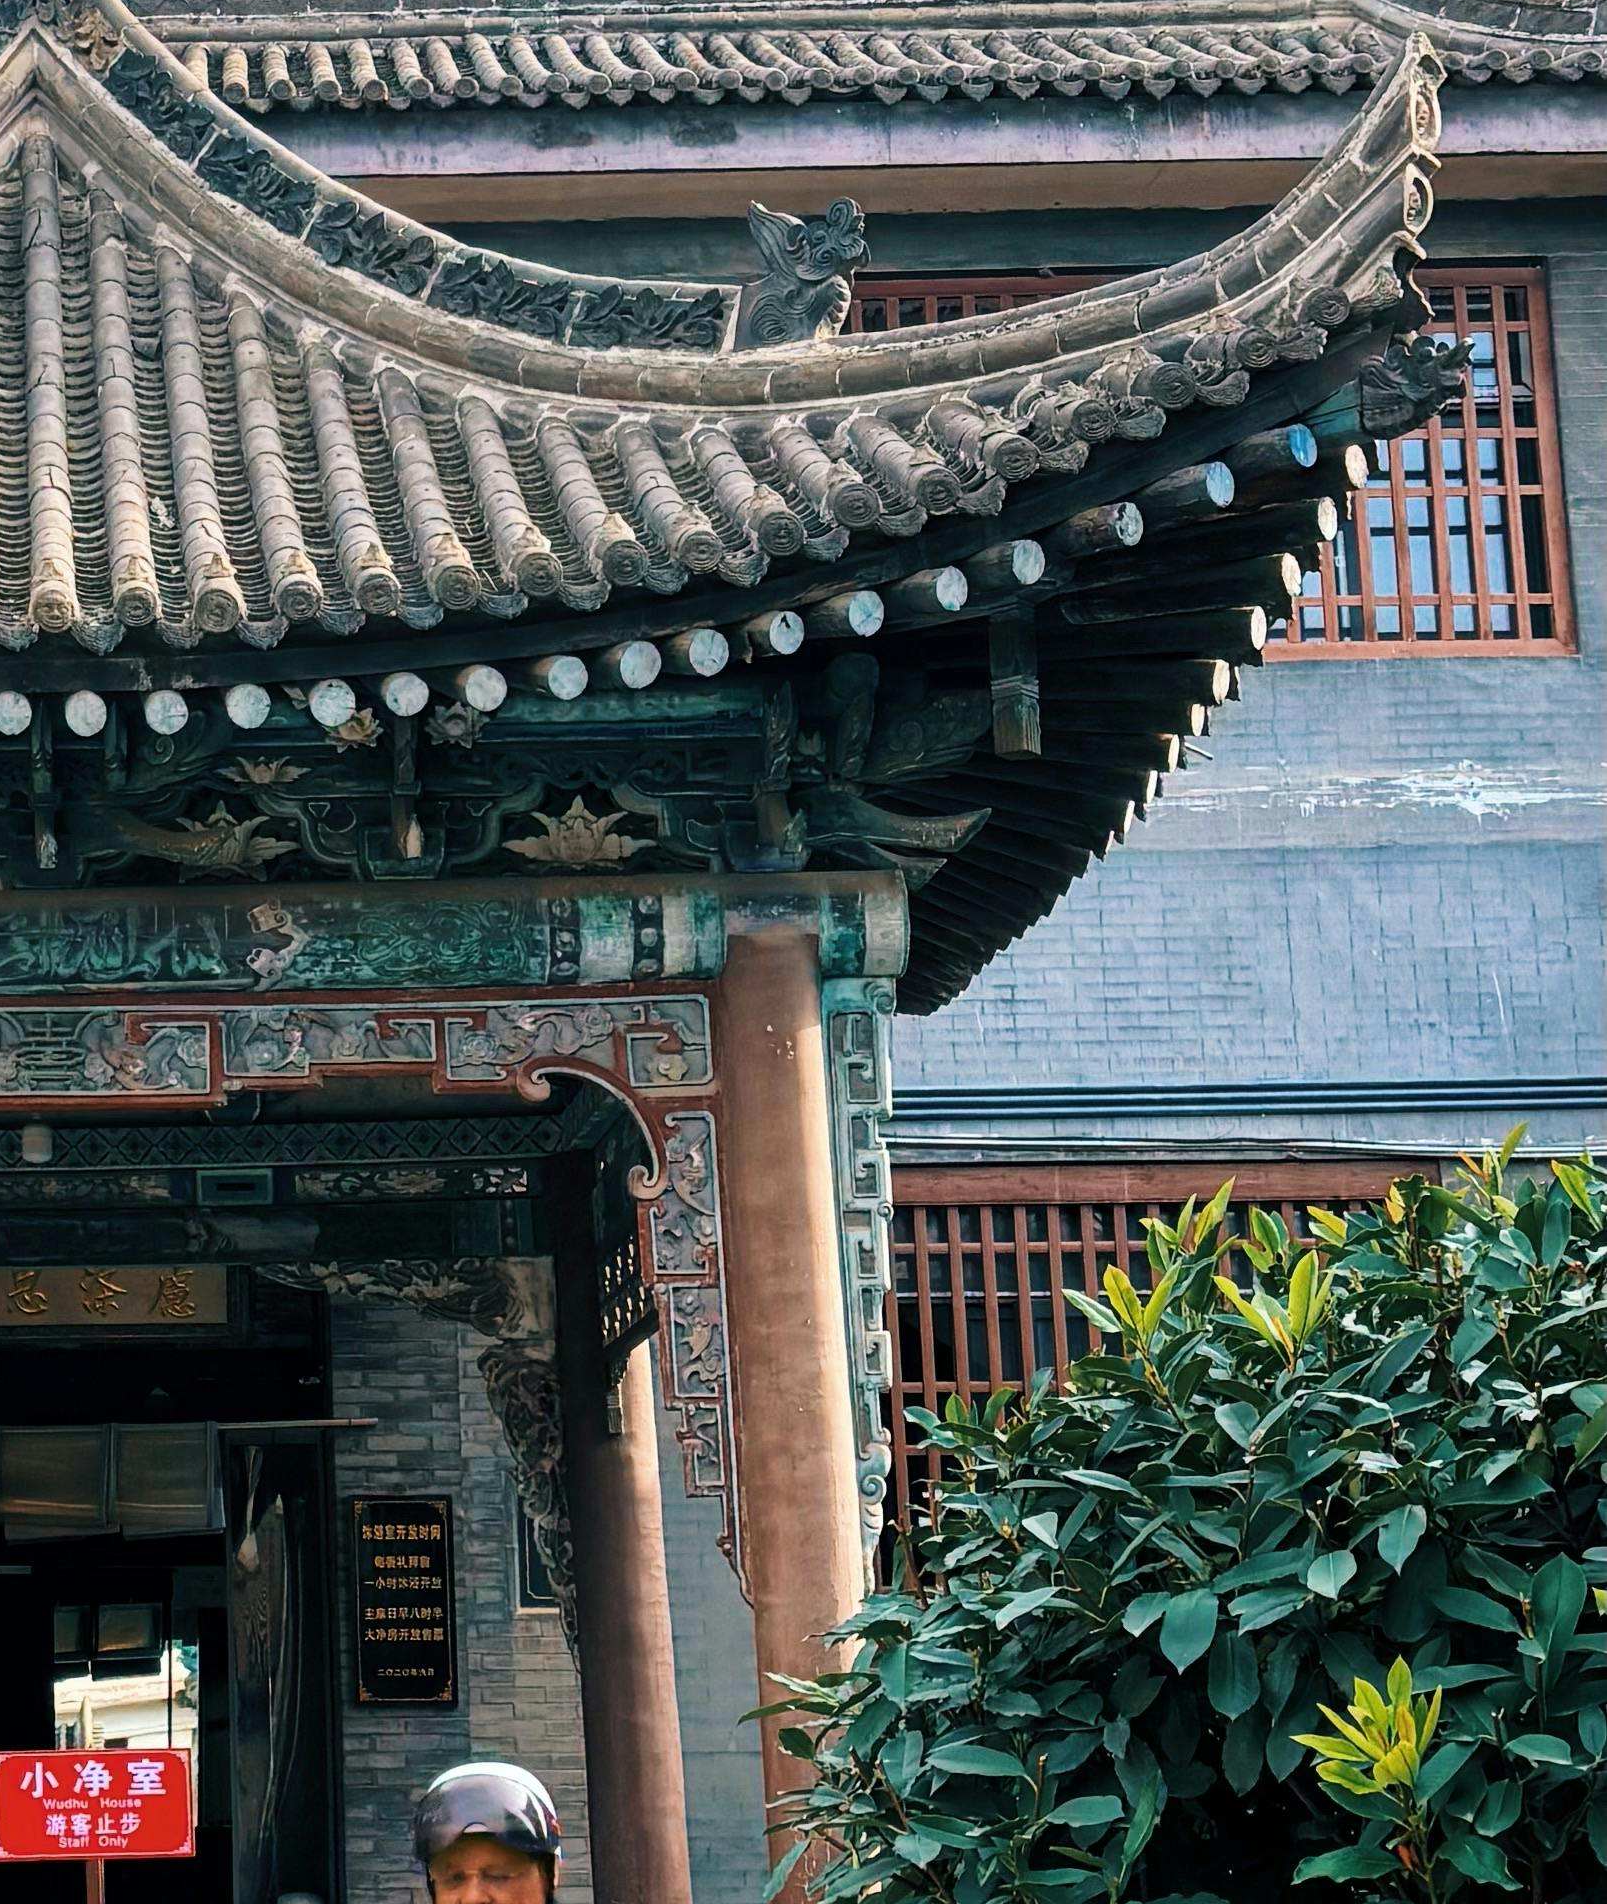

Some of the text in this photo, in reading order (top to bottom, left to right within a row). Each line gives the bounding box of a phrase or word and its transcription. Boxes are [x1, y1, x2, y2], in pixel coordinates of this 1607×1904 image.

[20, 1758, 167, 1798] 小净室
[43, 1797, 142, 1809] Wudhu House
[46, 1812, 142, 1837] 游客止步
[58, 1836, 128, 1848] Staff Only
